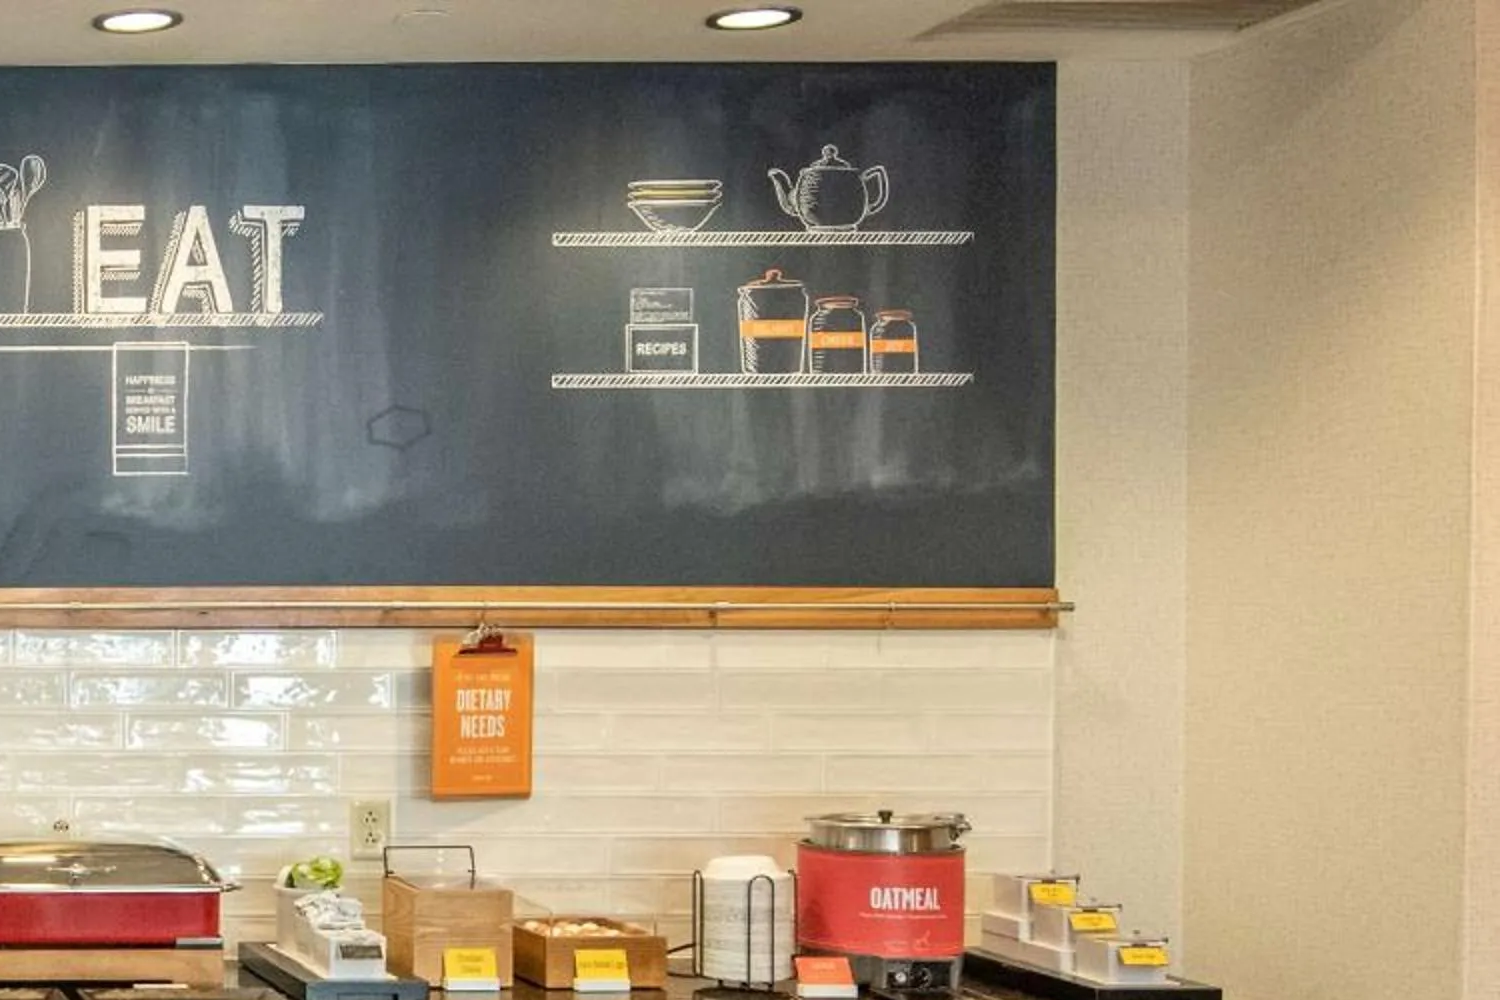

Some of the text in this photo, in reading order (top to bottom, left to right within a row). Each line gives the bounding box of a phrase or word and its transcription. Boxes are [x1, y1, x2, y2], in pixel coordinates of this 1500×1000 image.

[73, 204, 306, 314] EAT
[125, 415, 176, 434] SMILE
[455, 688, 513, 712] DIETARY
[460, 715, 506, 740] NEEDS
[870, 886, 942, 911] OATMEAL
